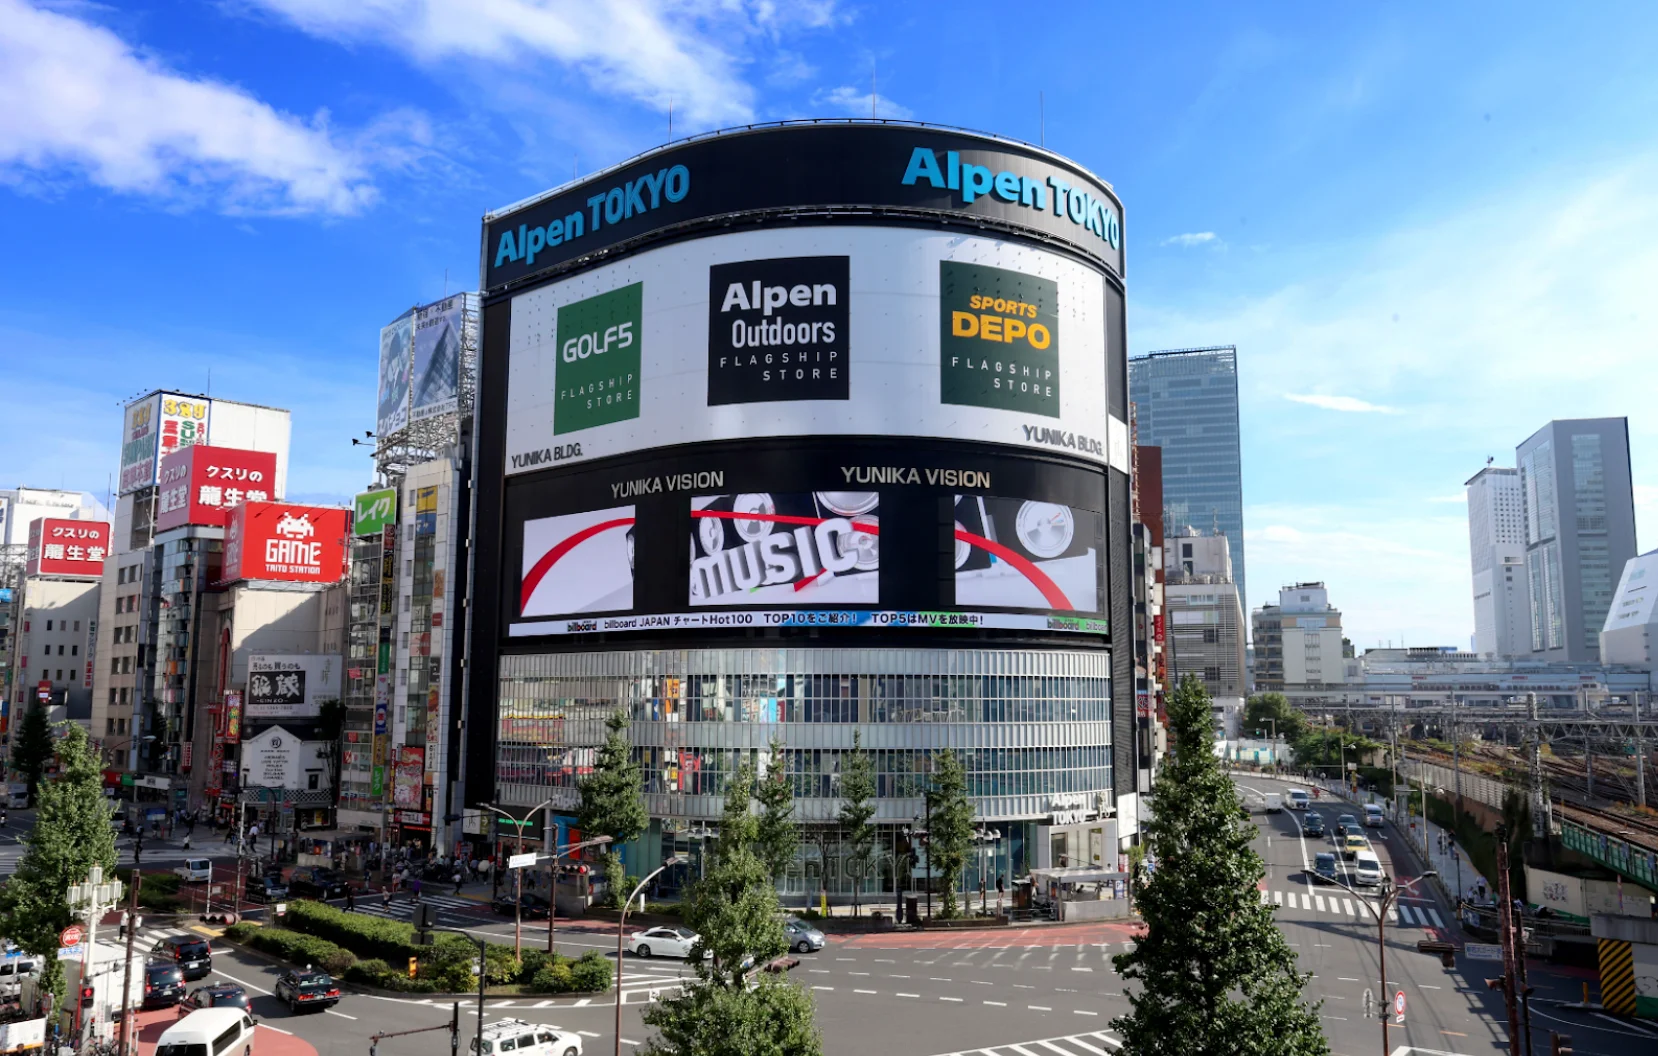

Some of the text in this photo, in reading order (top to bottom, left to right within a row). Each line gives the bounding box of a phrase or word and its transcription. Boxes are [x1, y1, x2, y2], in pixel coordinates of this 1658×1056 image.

[901, 146, 1120, 250] Alpen TOKYO
[494, 164, 690, 268] Alpen TOKYO
[720, 280, 837, 316] Alpen
[969, 295, 1038, 319] SPORTS
[732, 316, 836, 349] Outdoors
[952, 310, 1051, 350] DEPO
[562, 321, 633, 363] GOLF5
[720, 351, 838, 368] FLAGSHIP
[952, 356, 1052, 380] FLAGSHIP
[762, 368, 838, 381] STORE
[561, 373, 633, 400] FLAGSHIP
[994, 378, 1052, 397] STORE
[586, 390, 633, 409] STORE
[1022, 424, 1077, 449] YUNIKA
[511, 442, 583, 469] YUNIKA BLDG.
[163, 464, 187, 485] クスリの
[206, 465, 263, 483] クスリの
[611, 471, 724, 499] YUNIKA VISION
[841, 466, 990, 489] YUNIKA VISION
[198, 485, 268, 507] 龍生堂
[356, 496, 391, 524] レイク
[52, 527, 100, 539] クスリの
[44, 543, 105, 562] 龍生堂
[265, 539, 322, 565] GAME
[265, 564, 320, 574] TAITO STATION
[603, 619, 637, 629] billboard
[639, 616, 670, 627] JAPAN
[674, 613, 753, 626] チャートHot100
[1052, 793, 1087, 808] Alpen
[1052, 810, 1087, 825] TOKYO
